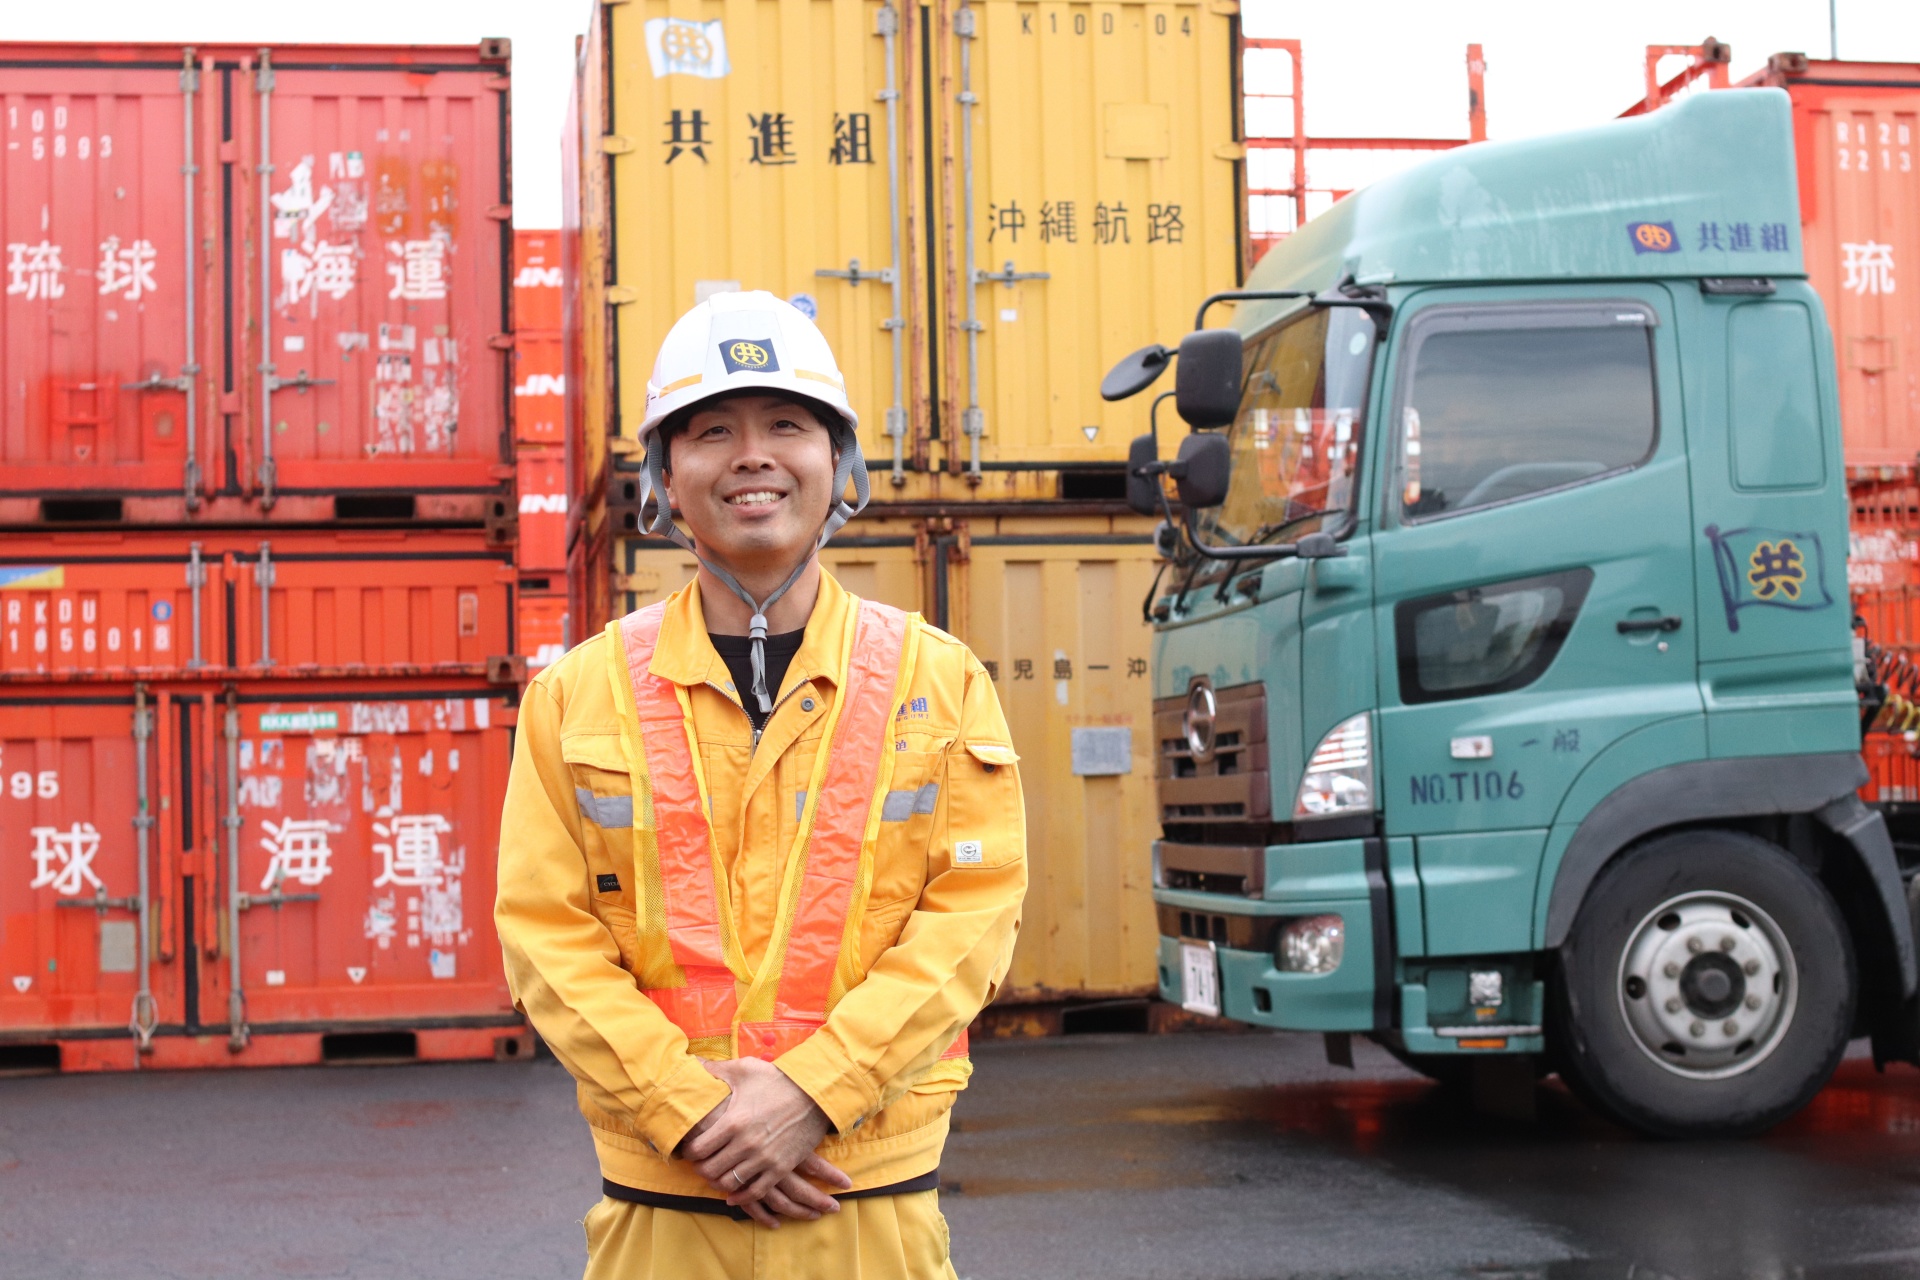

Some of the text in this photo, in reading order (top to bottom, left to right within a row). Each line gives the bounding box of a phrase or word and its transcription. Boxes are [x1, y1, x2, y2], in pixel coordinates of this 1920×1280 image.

[662, 109, 876, 165] 共進組
[1838, 148, 1911, 172] 2213
[988, 200, 1185, 244] 沖縄航路
[1698, 221, 1789, 252] 共進組
[1841, 240, 1895, 296] 琉
[1748, 540, 1806, 600] 共
[1411, 770, 1524, 805] NO.T106
